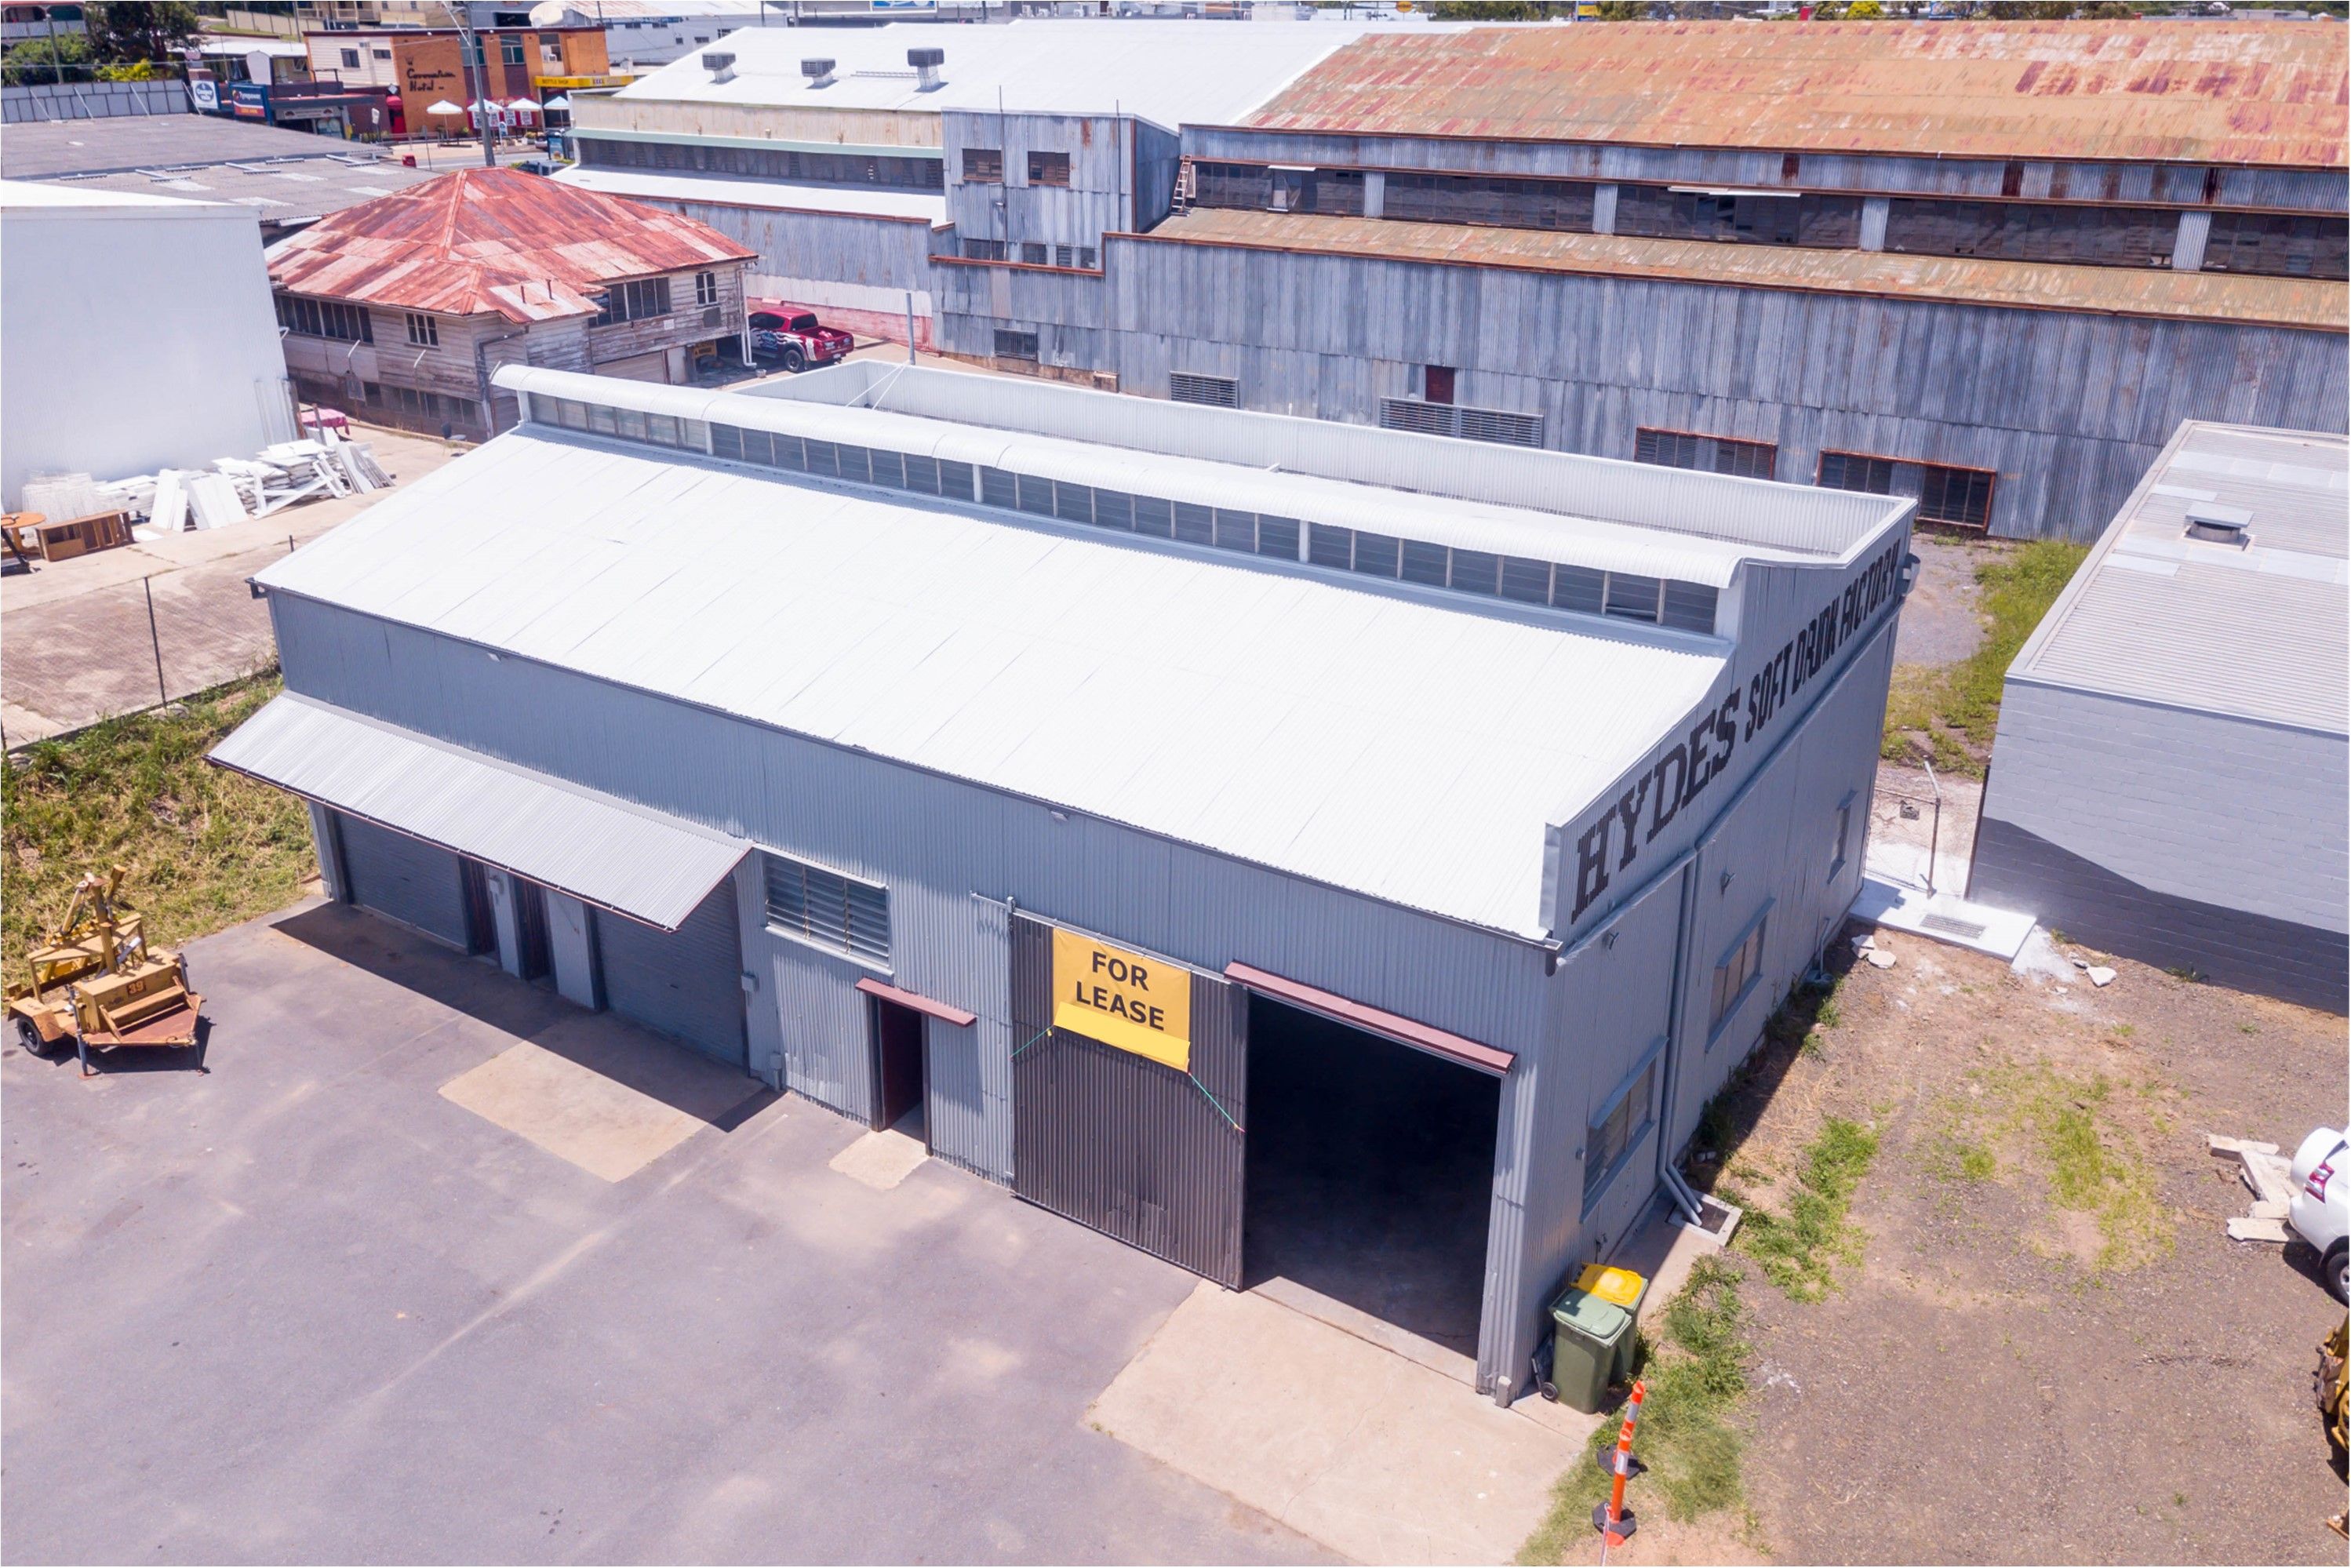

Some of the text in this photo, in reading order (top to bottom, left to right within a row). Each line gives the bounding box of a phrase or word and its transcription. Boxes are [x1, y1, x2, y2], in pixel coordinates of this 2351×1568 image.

[409, 79, 434, 92] Hotel
[1571, 538, 1901, 926] HYDES SOFT DRINK FACTORY
[128, 980, 144, 995] 39
[1091, 950, 1149, 991] FOR
[1075, 980, 1165, 1031] LEASE
